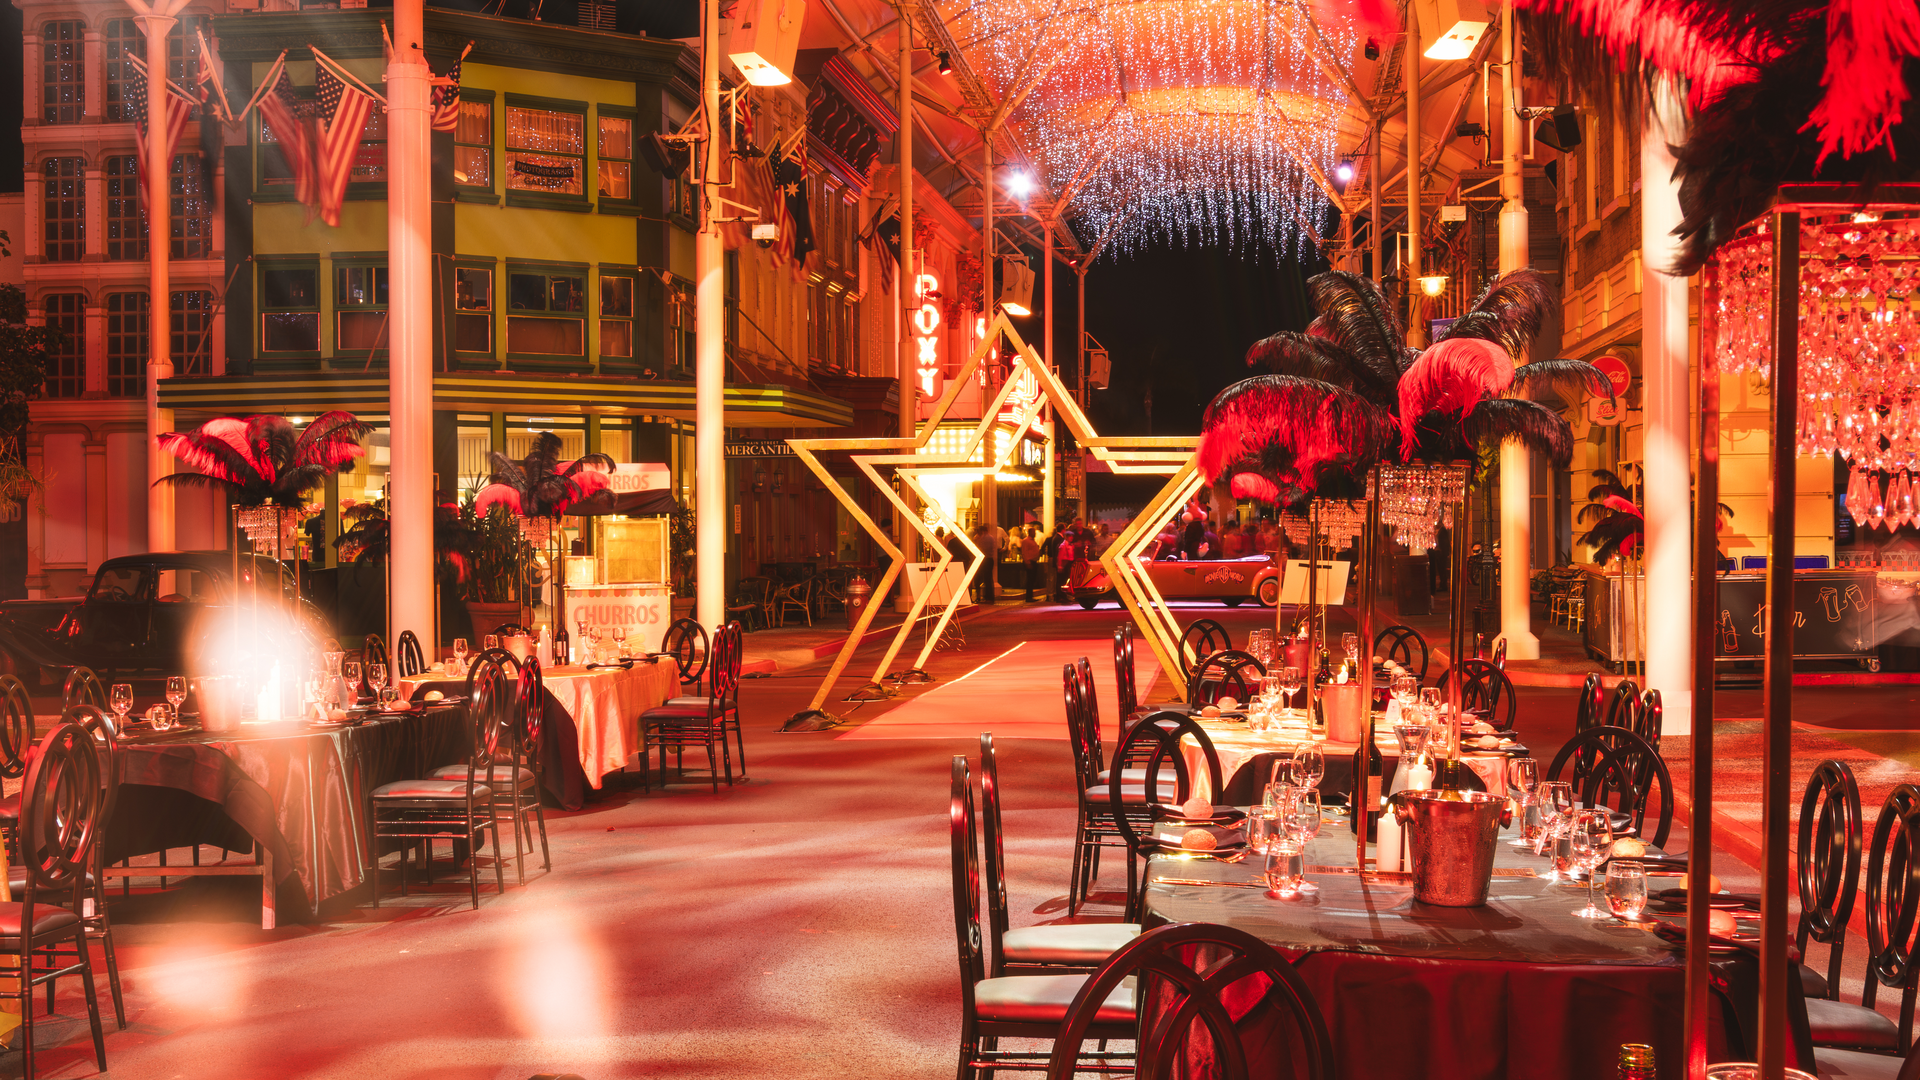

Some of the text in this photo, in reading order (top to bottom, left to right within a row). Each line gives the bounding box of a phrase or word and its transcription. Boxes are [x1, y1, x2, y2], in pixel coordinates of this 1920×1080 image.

[350, 167, 370, 176] TUNT
[517, 163, 572, 175] PHOTOGRAPHIC
[524, 177, 564, 187] GALLERY
[915, 274, 940, 397] ROXY
[725, 445, 798, 455] MERCANTIL
[608, 474, 650, 489] RROS
[574, 604, 660, 626] CHURROS
